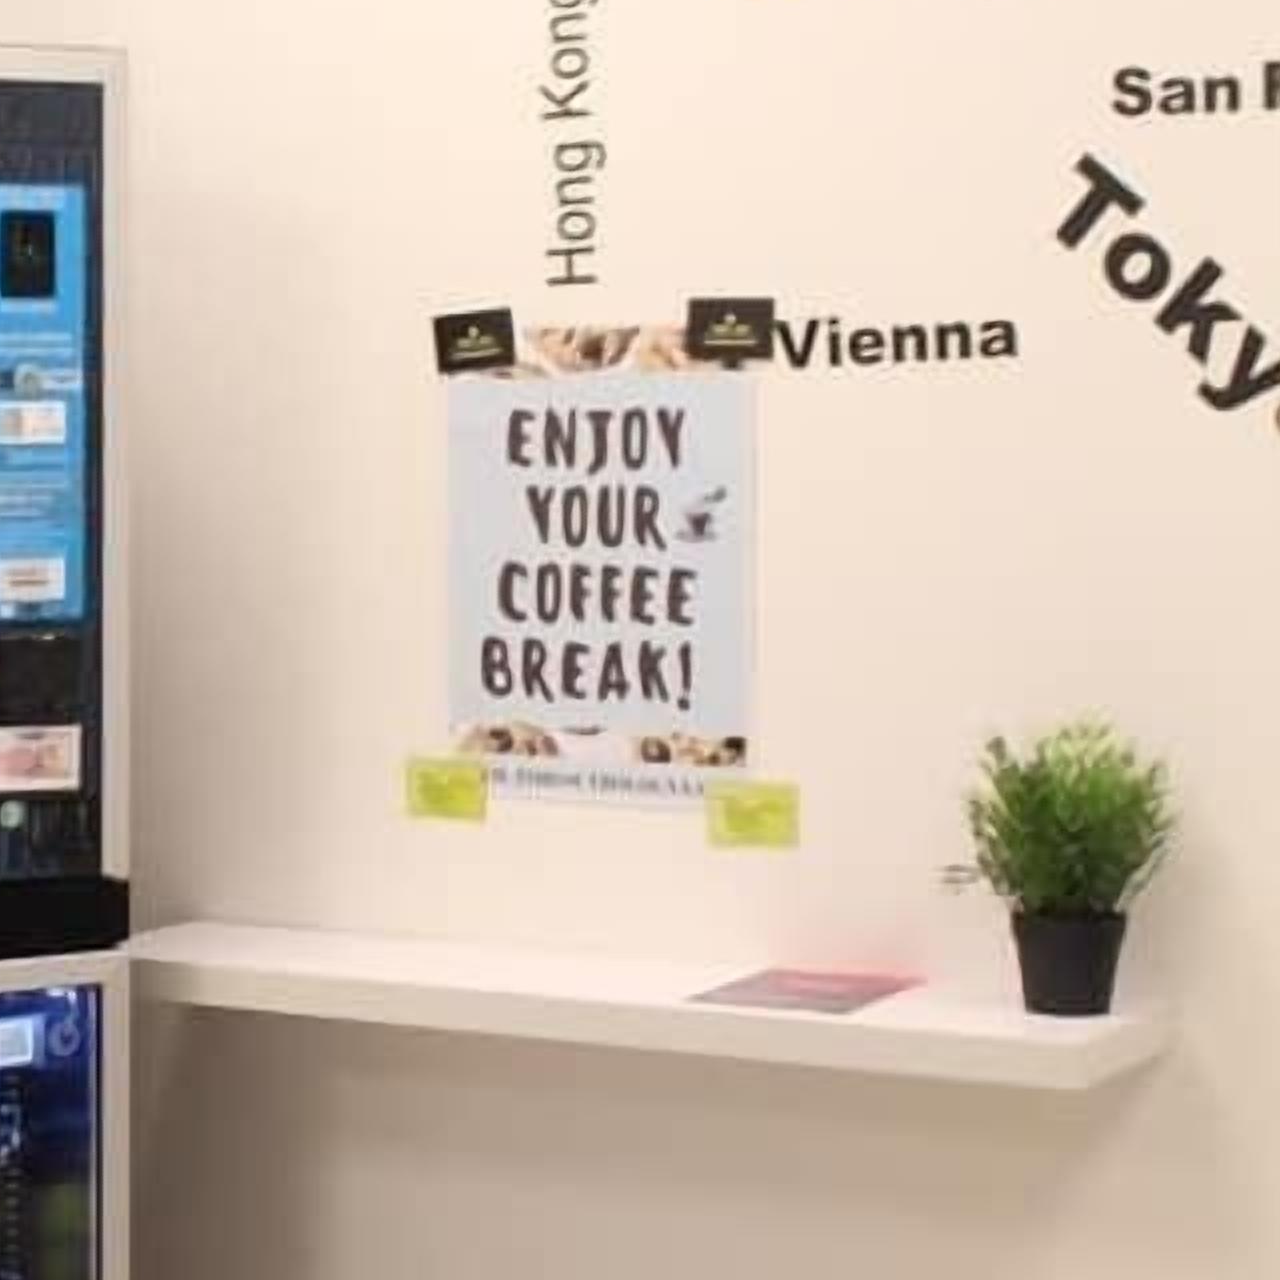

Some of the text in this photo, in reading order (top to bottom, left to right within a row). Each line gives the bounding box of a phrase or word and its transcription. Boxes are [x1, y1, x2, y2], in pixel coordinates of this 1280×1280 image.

[1111, 66, 1241, 118] San
[544, 140, 608, 288] Hong
[1055, 152, 1280, 428] Toky
[775, 316, 1020, 370] Vienna
[506, 406, 686, 472] ENJOY
[524, 483, 668, 552] YOUR
[496, 560, 698, 628] COFFEE
[479, 634, 694, 711] BREAK!
